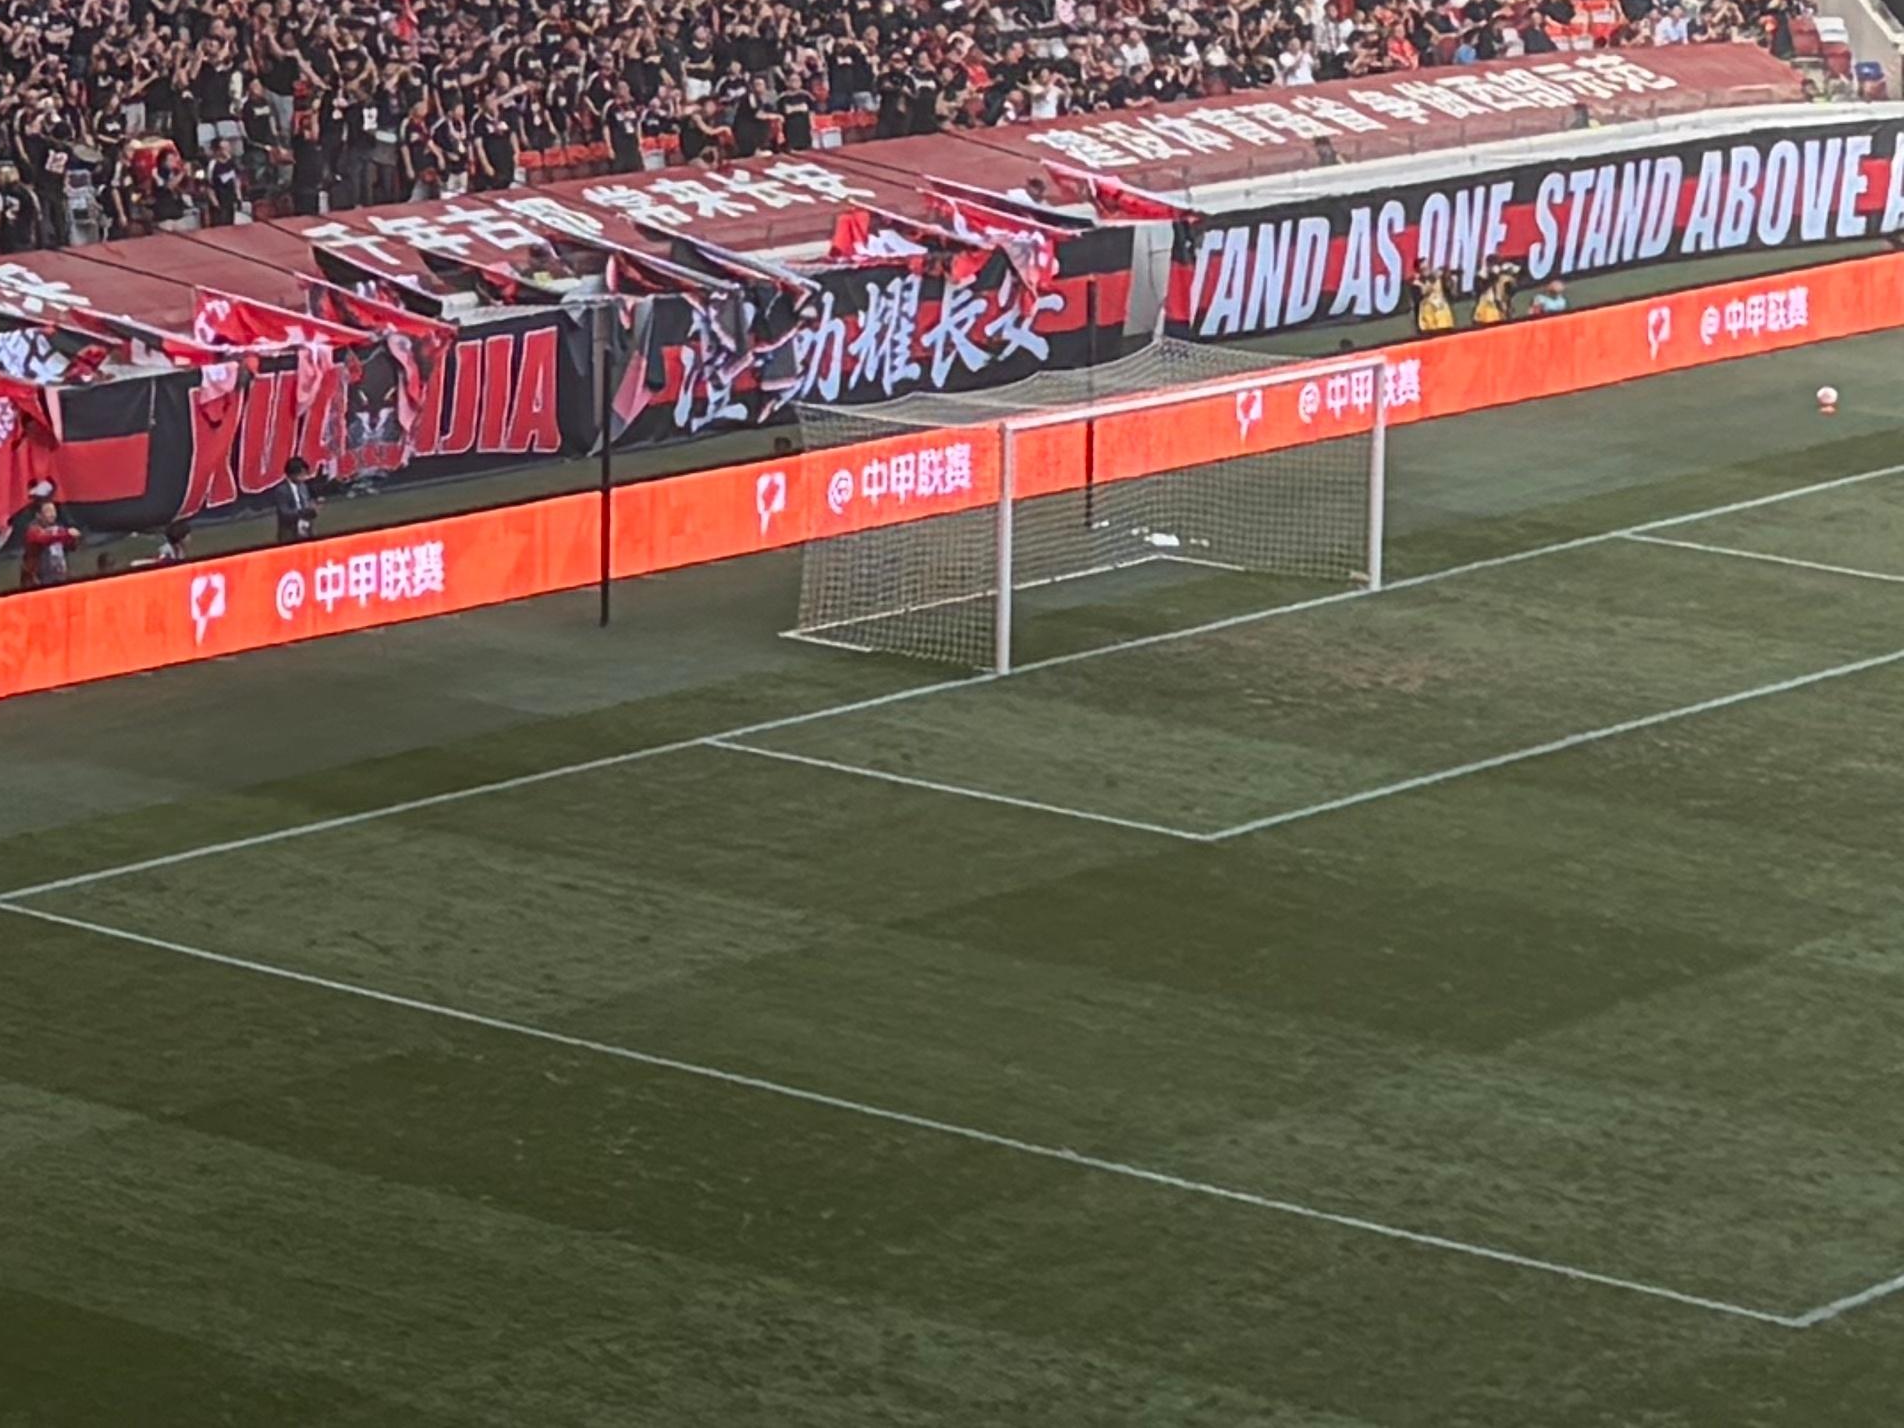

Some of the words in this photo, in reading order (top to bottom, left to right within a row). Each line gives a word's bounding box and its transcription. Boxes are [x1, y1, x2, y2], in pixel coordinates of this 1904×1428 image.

[1026, 92, 1391, 171] 建设体育强省
[582, 160, 877, 231] 常来长安
[1189, 216, 1331, 337] TAND
[1328, 199, 1407, 317] AS
[1418, 180, 1515, 294] ONE
[1528, 155, 1684, 282] STAND
[1680, 134, 1873, 255] ABOVE
